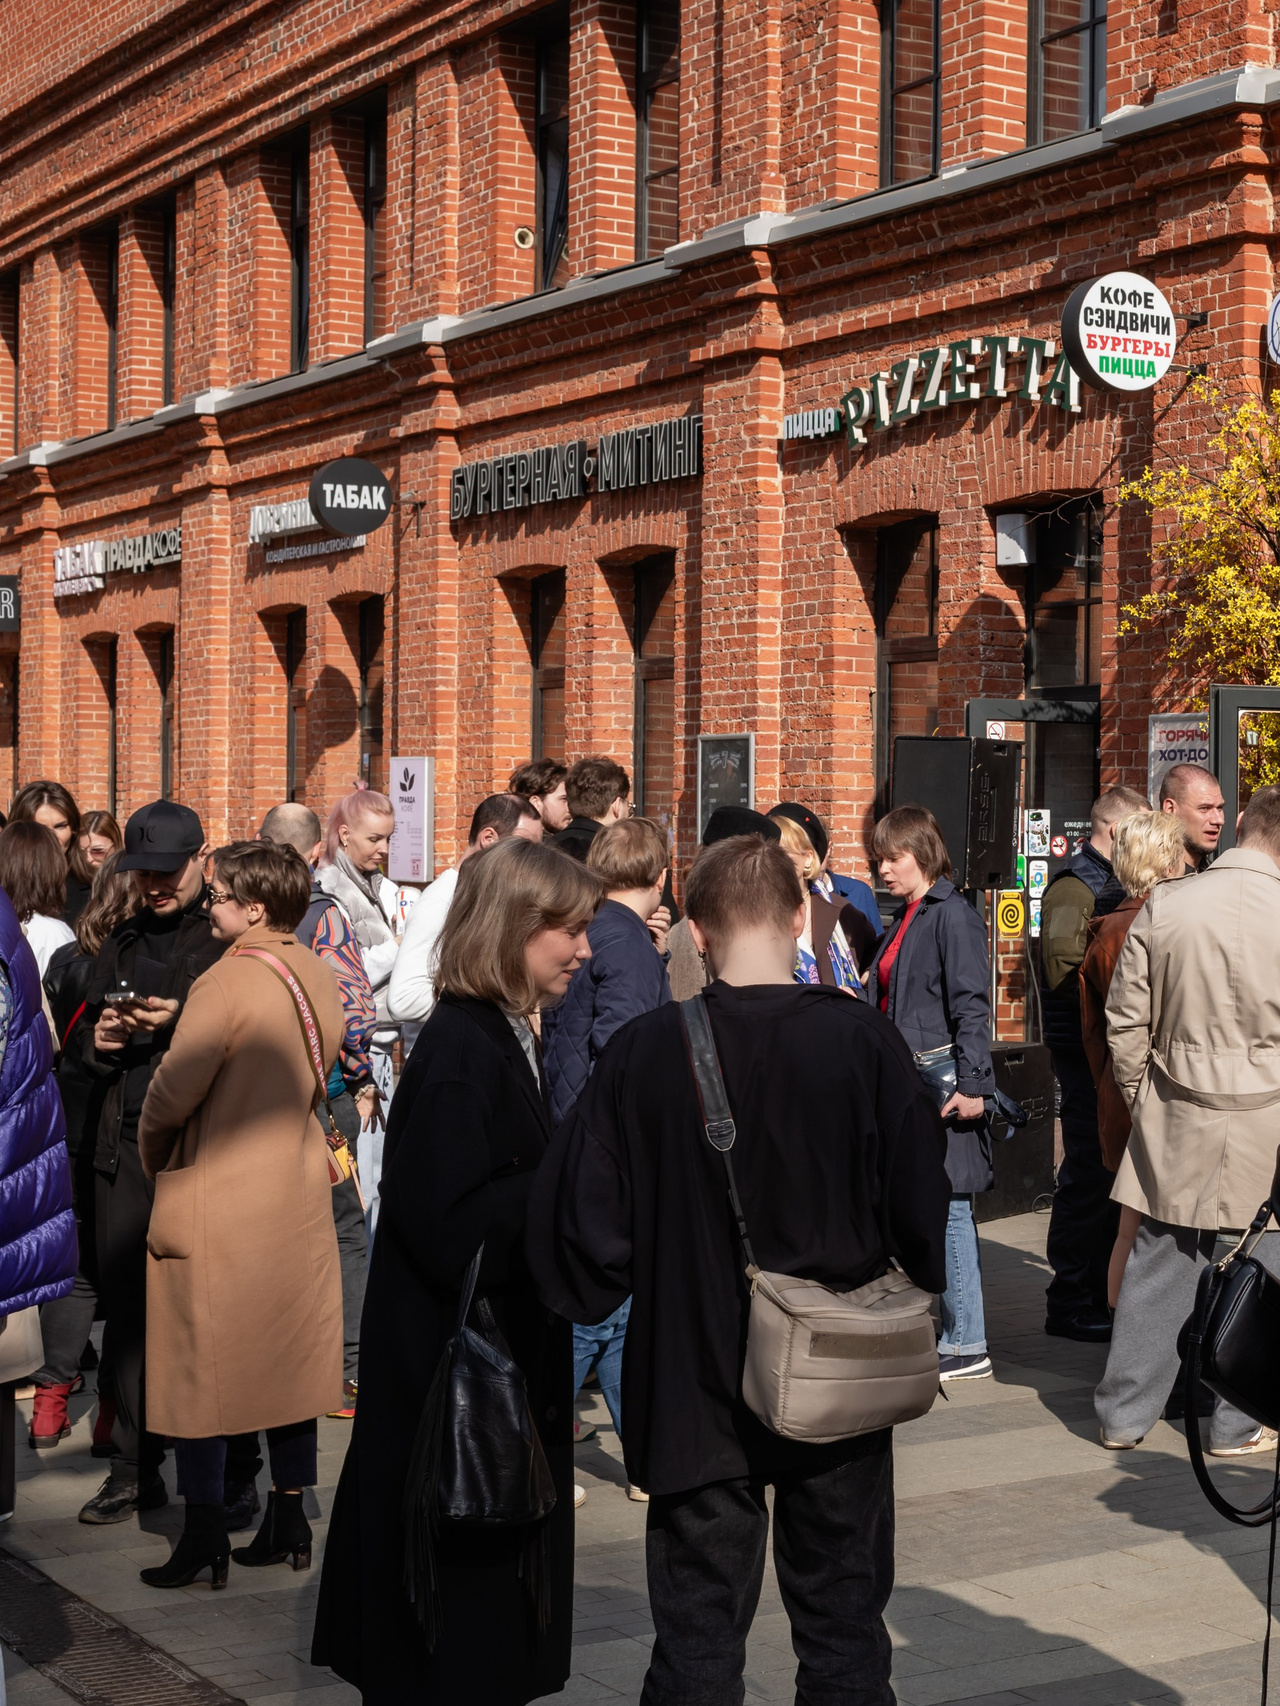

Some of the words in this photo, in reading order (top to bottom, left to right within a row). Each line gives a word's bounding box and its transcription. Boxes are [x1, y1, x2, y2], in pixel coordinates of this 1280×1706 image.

[1100, 286, 1155, 309] КОФЕ
[1083, 306, 1171, 336] СЭНДВИЧИ
[1086, 333, 1171, 358] БУРГЕРЫ
[1099, 355, 1157, 380] ПИЦЦА
[840, 336, 1082, 450] PIZZETTA
[783, 407, 841, 440] ПИЦЦА
[451, 440, 584, 521] БУРГЕРНАЯ
[598, 414, 703, 492] МИТИНГ
[322, 483, 387, 510] ТАБАК
[53, 541, 104, 581] ТАБАК
[102, 534, 153, 574] ПРАВДА
[286, 974, 315, 1026] JACOBS
[307, 1027, 324, 1065] MARC
